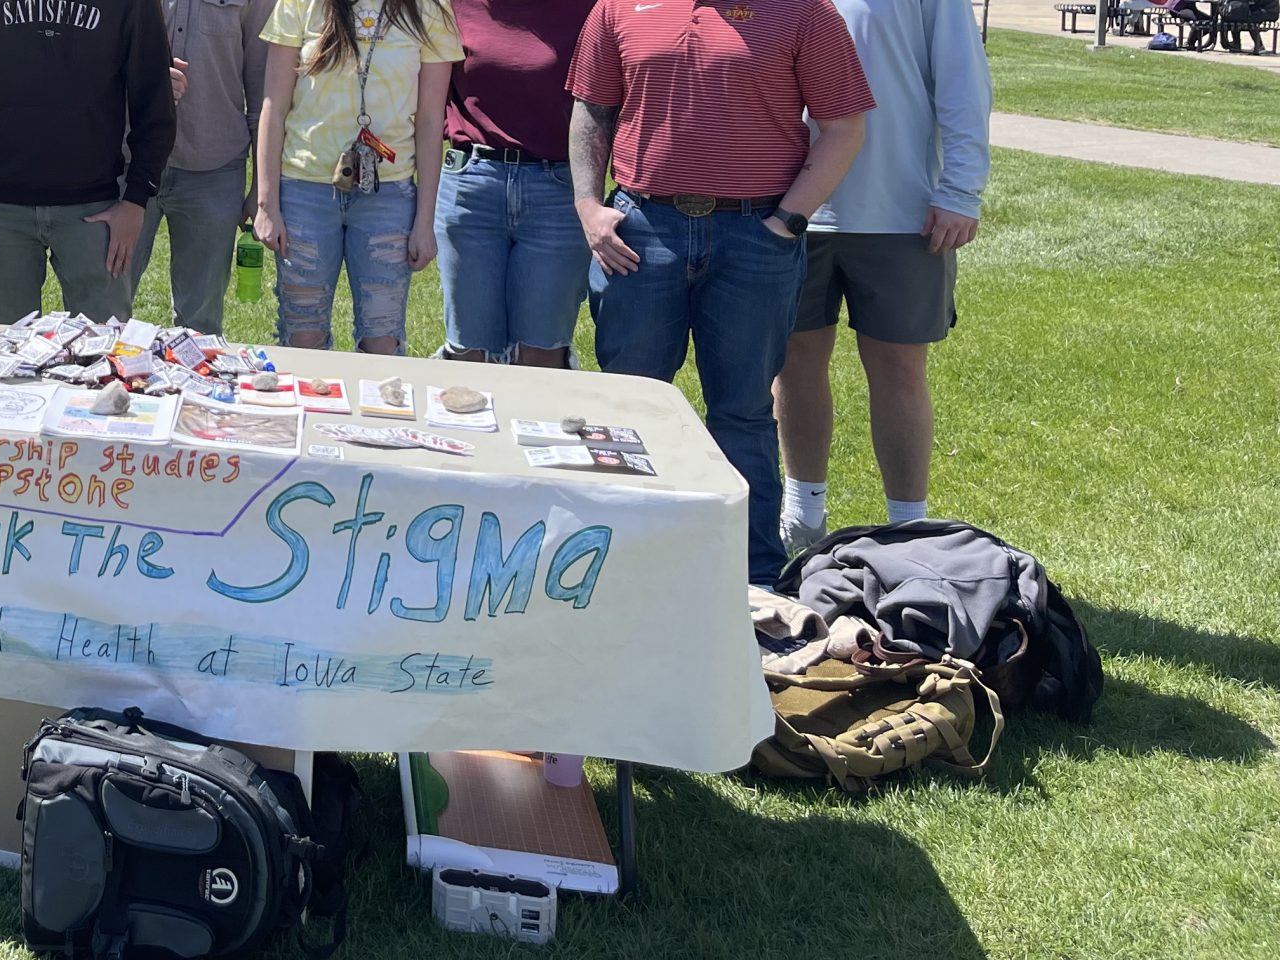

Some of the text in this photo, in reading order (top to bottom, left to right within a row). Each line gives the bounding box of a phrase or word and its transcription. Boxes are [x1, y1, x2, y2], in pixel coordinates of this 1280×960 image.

[61, 520, 175, 579] The
[56, 612, 156, 665] Health
[197, 633, 240, 677] at
[391, 652, 495, 694] State
